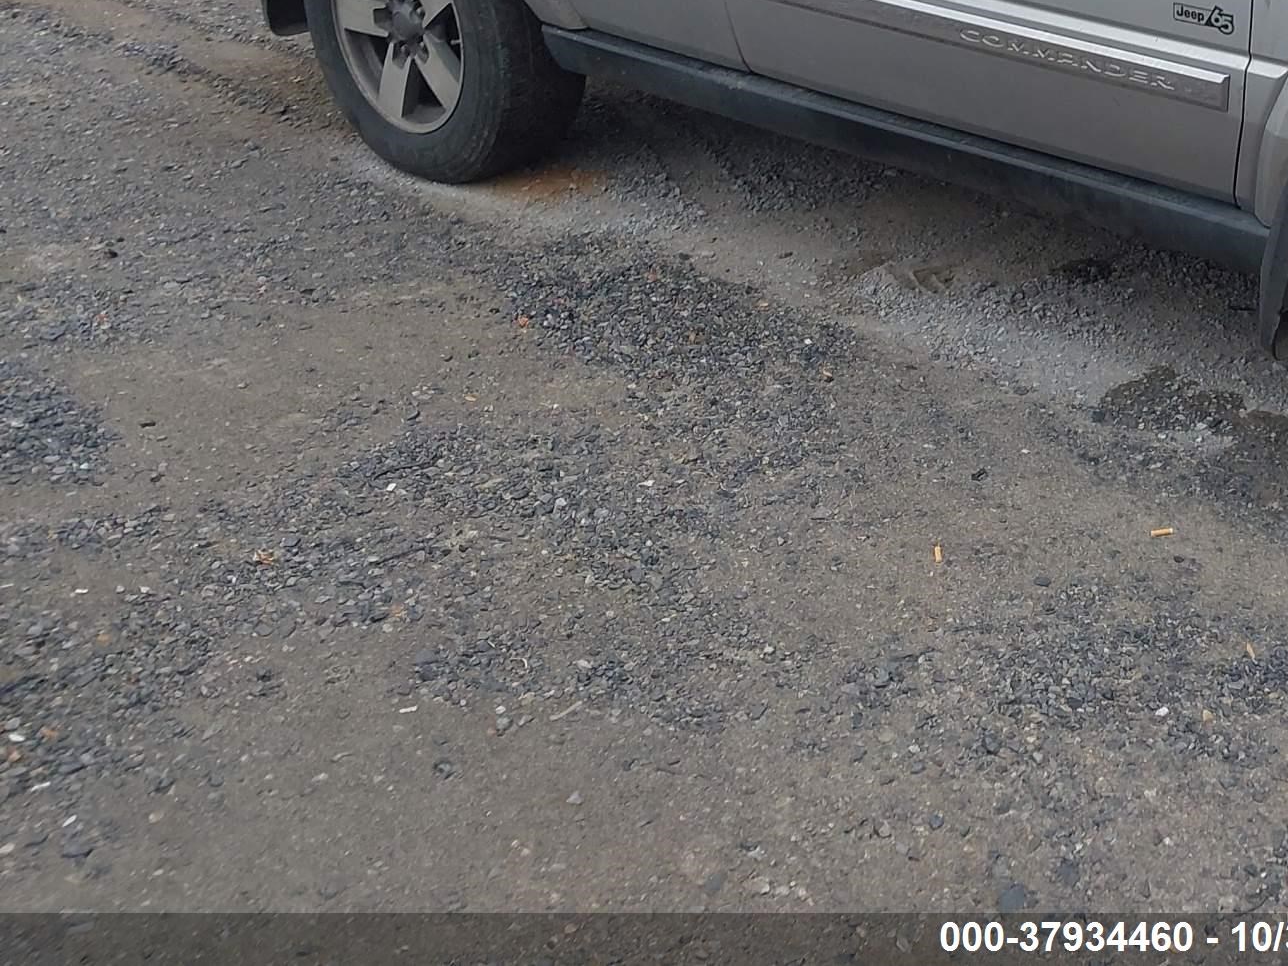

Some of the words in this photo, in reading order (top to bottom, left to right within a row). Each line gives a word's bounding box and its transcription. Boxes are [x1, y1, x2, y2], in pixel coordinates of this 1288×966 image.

[1176, 4, 1205, 23] Jeep
[1209, 5, 1235, 35] 65
[959, 29, 1175, 91] COMMANDER
